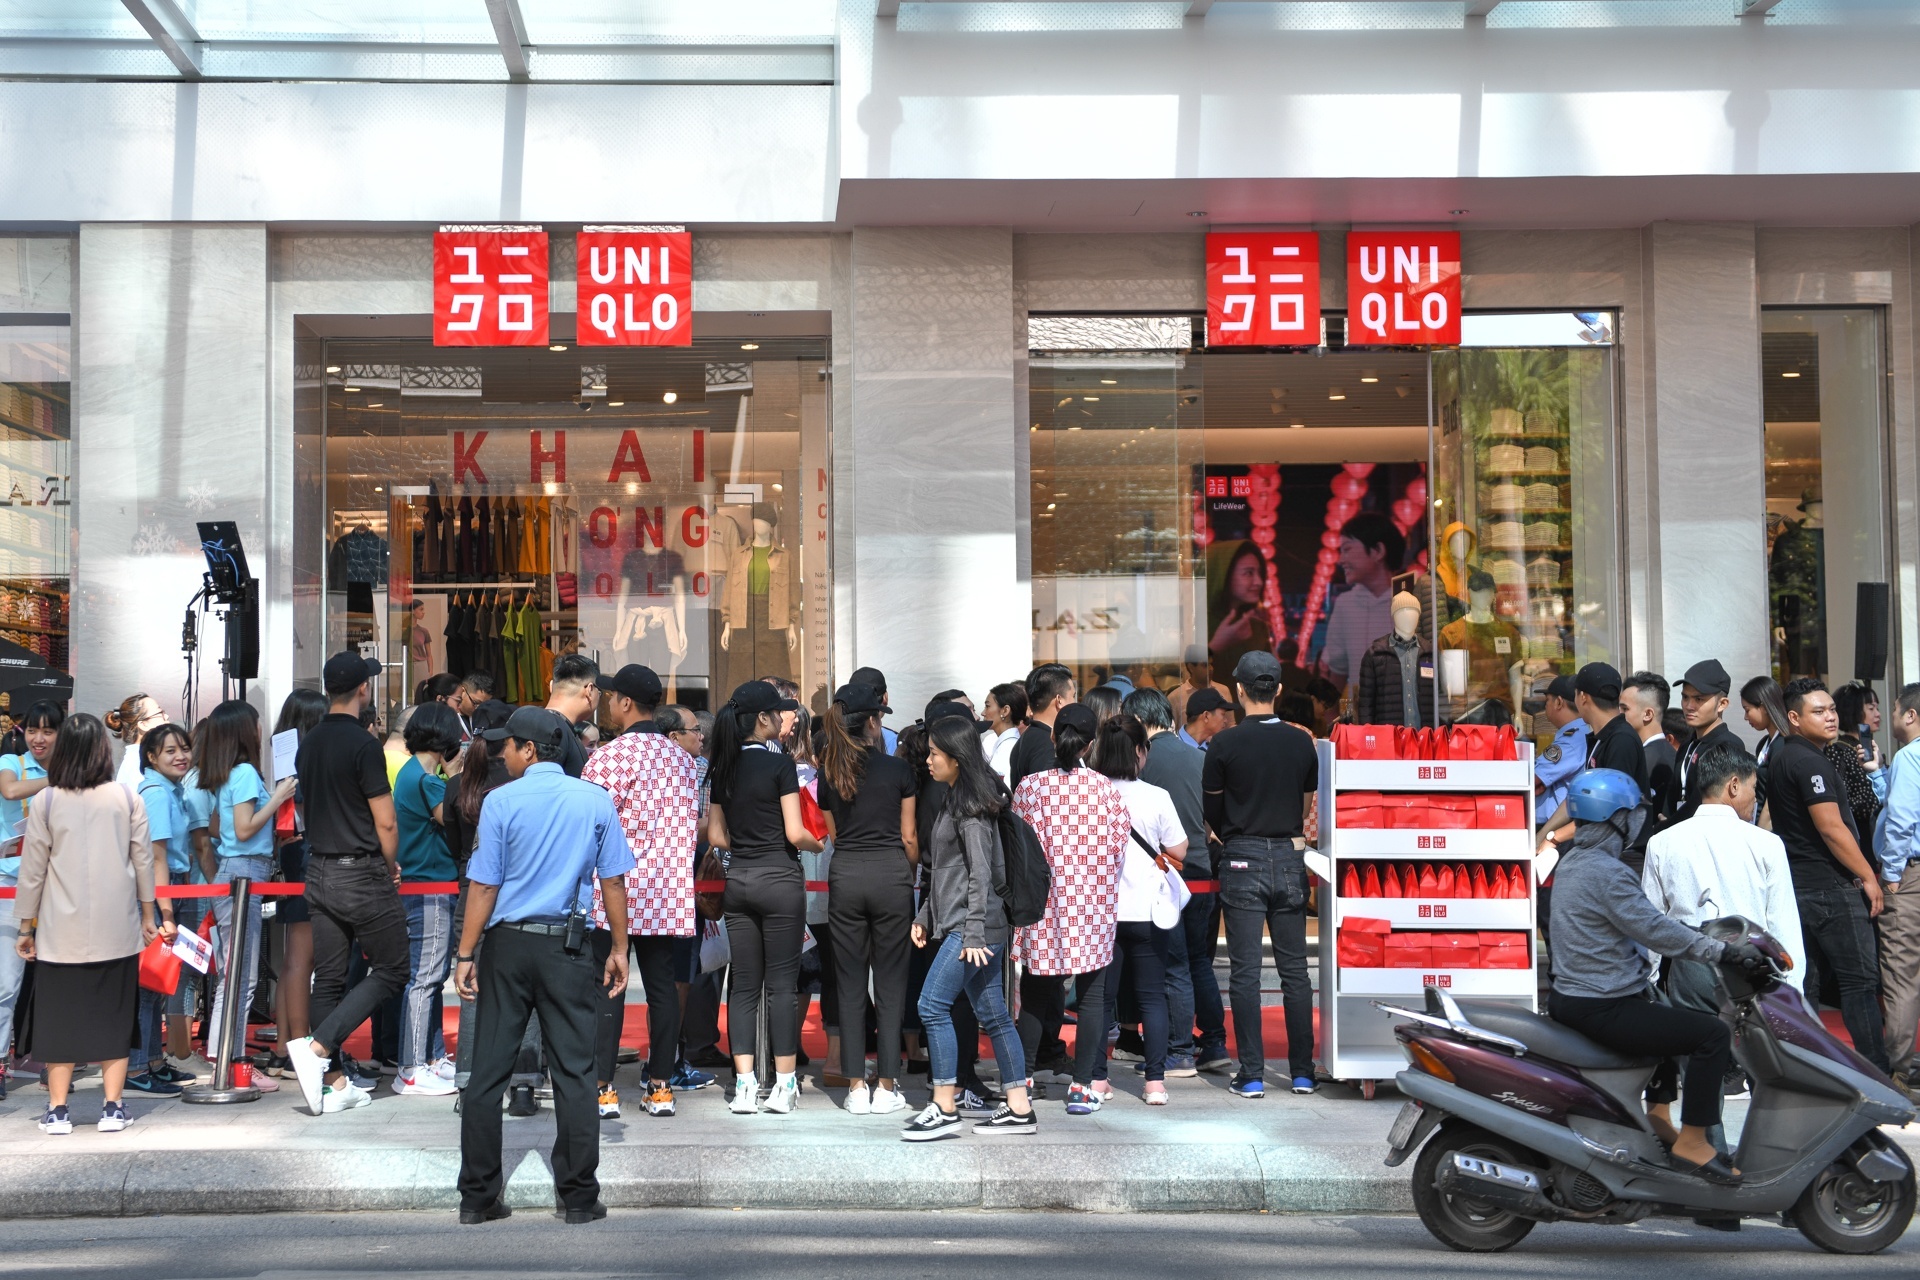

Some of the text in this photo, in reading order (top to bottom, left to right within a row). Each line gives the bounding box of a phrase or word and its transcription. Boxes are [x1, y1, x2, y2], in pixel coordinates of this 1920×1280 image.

[449, 247, 532, 283] ユニ
[590, 247, 669, 284] UNI
[1222, 247, 1304, 283] ユニ
[1360, 246, 1438, 284] UNI
[447, 294, 533, 331] クロ
[590, 293, 678, 338] QLO
[1220, 294, 1304, 330] クロ
[1361, 292, 1448, 337] QLO
[1213, 502, 1246, 510] LifeWear
[0, 658, 30, 666] SHURE
[1811, 775, 1826, 794] 3
[1491, 1091, 1544, 1111] Spacy
